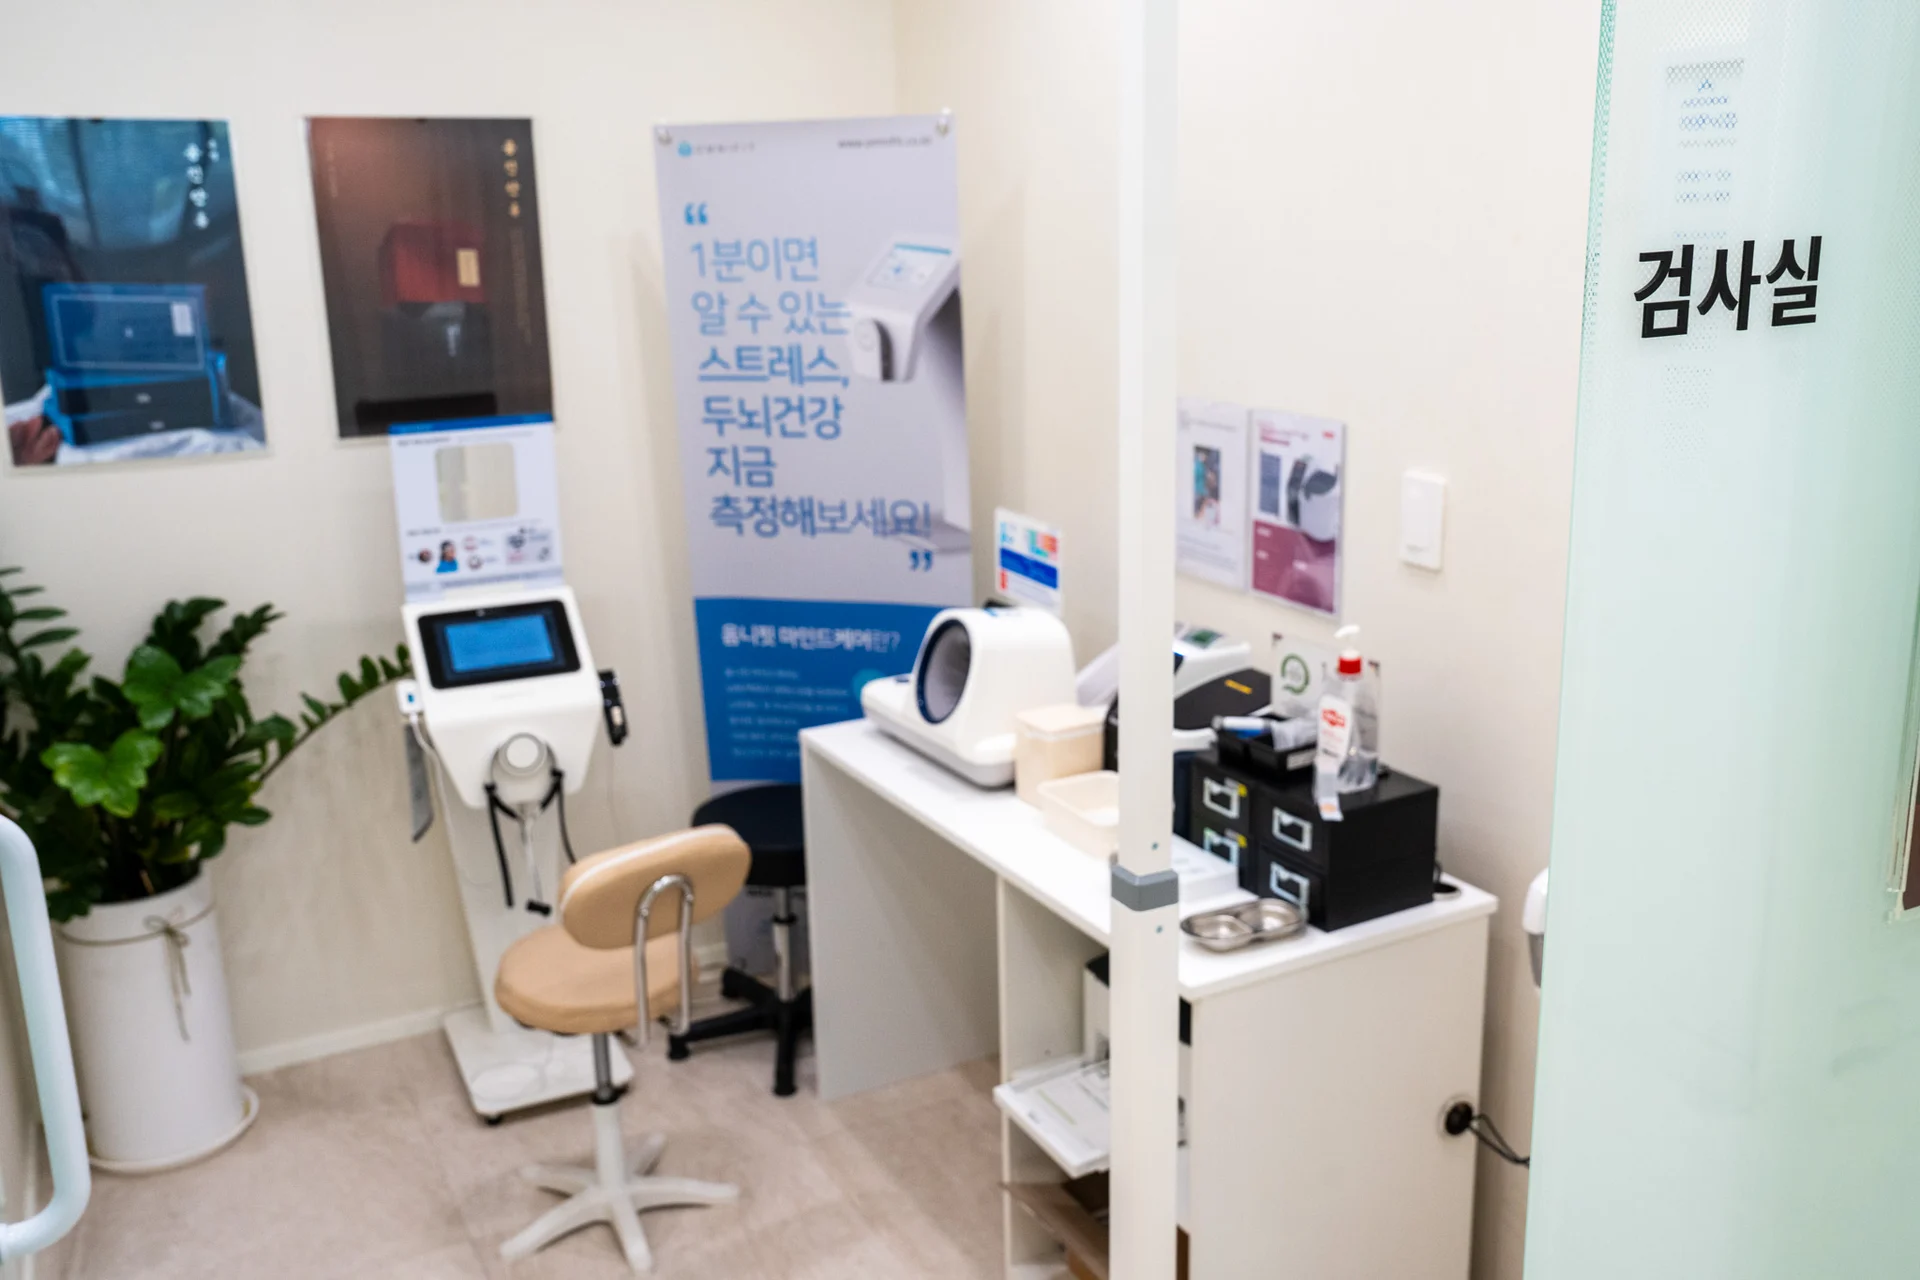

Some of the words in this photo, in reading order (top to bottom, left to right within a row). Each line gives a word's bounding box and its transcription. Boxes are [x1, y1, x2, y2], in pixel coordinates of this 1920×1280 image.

[690, 236, 819, 283] 1분이면
[1634, 236, 1822, 338] 검사실
[691, 291, 728, 336] 알
[737, 294, 772, 335] 수
[778, 291, 851, 336] 있는
[698, 344, 849, 387] 스트레스,
[702, 394, 845, 440] 두뇌건강
[707, 444, 776, 488] 지금
[710, 493, 932, 538] 측정해보세요!
